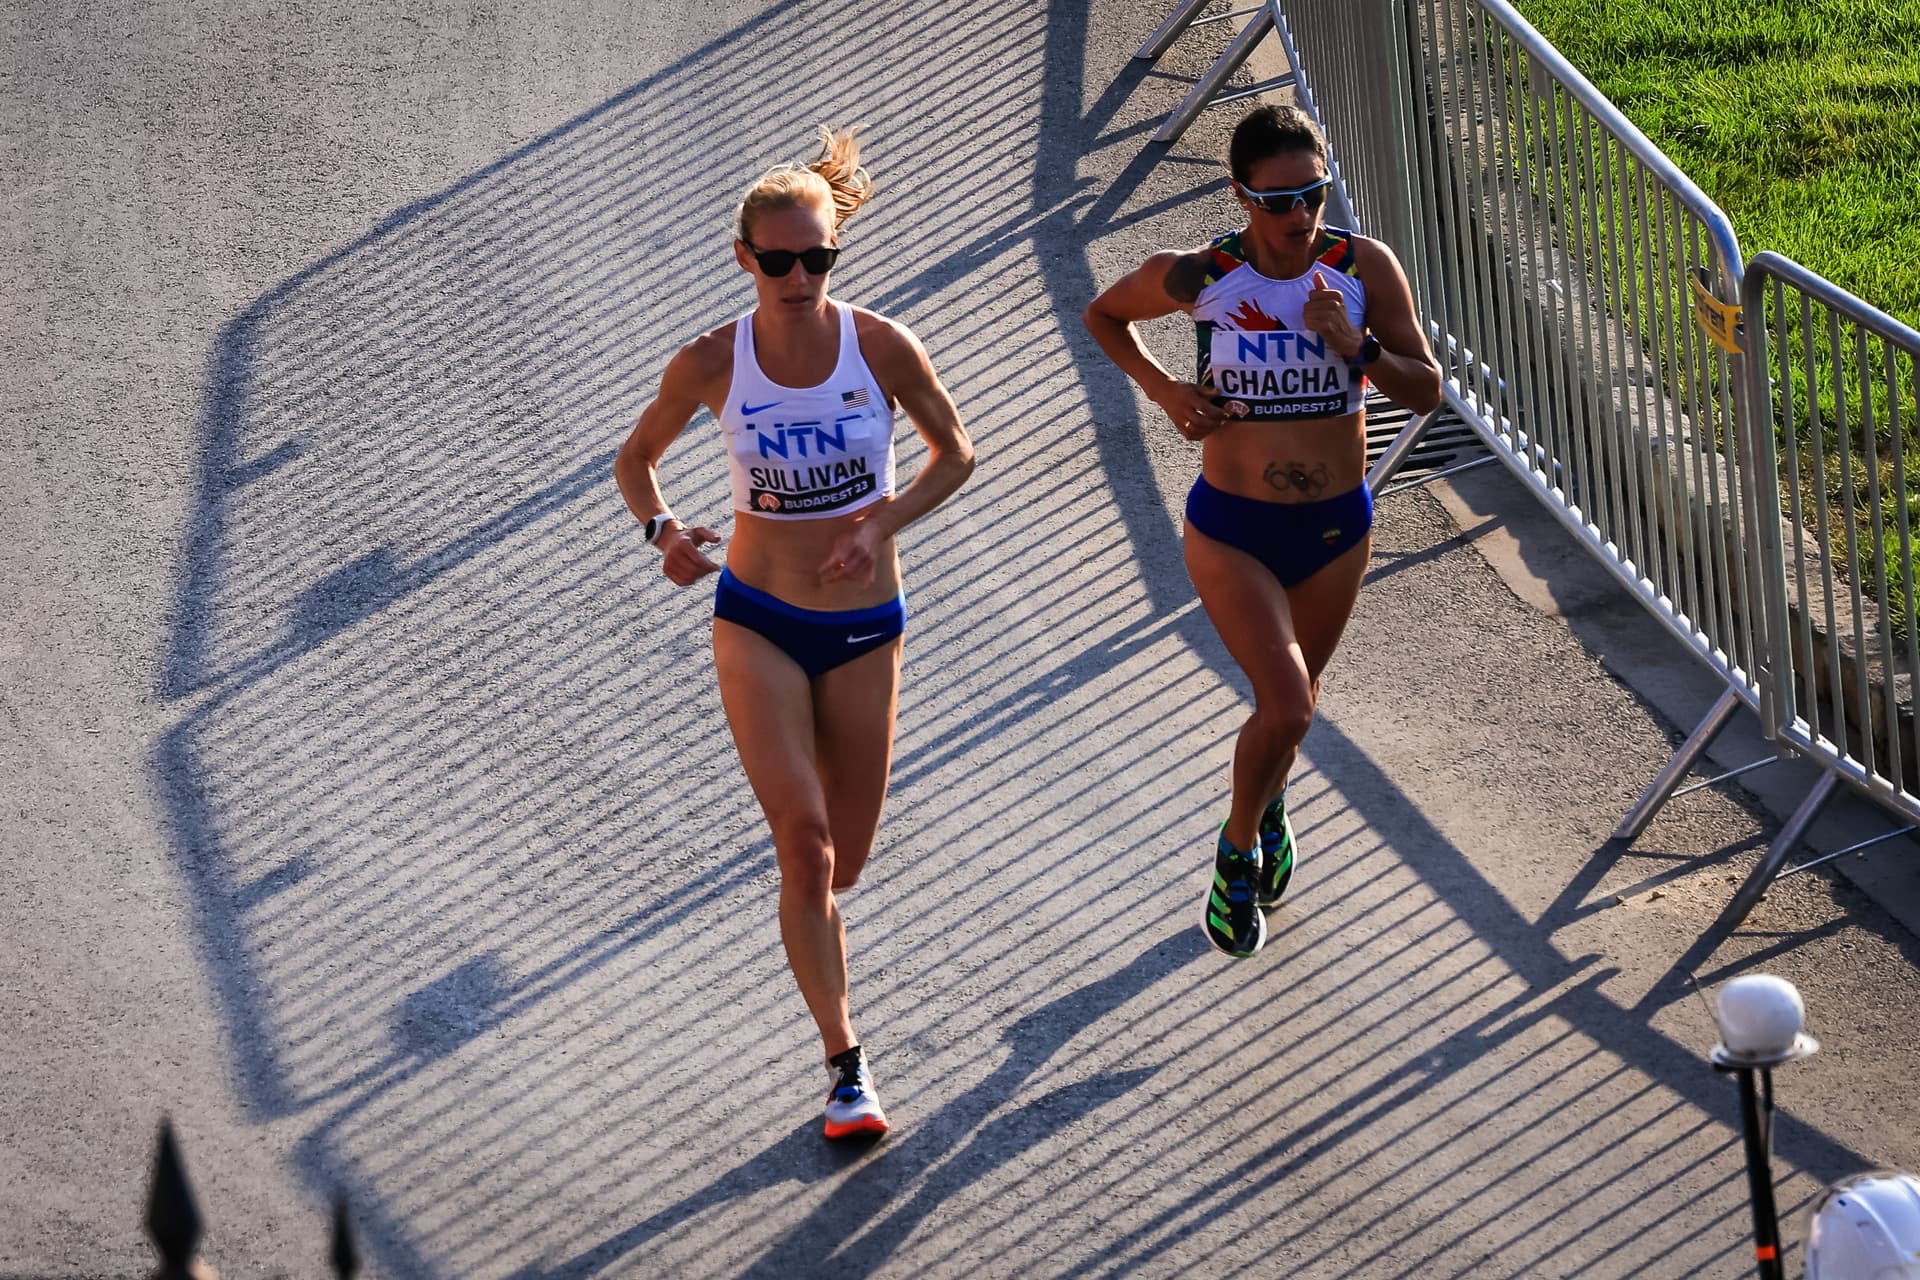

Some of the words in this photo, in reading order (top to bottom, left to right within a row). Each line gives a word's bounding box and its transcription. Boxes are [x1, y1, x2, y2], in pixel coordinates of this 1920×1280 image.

[1238, 333, 1325, 364] NTN
[1220, 366, 1340, 396] CHACHA
[1254, 402, 1326, 415] BUDAPEST
[1328, 400, 1341, 411] 23
[758, 423, 847, 460] NTN
[750, 456, 867, 493] SULLIVAN
[784, 491, 853, 509] BUDAPEST
[854, 480, 869, 494] 23
